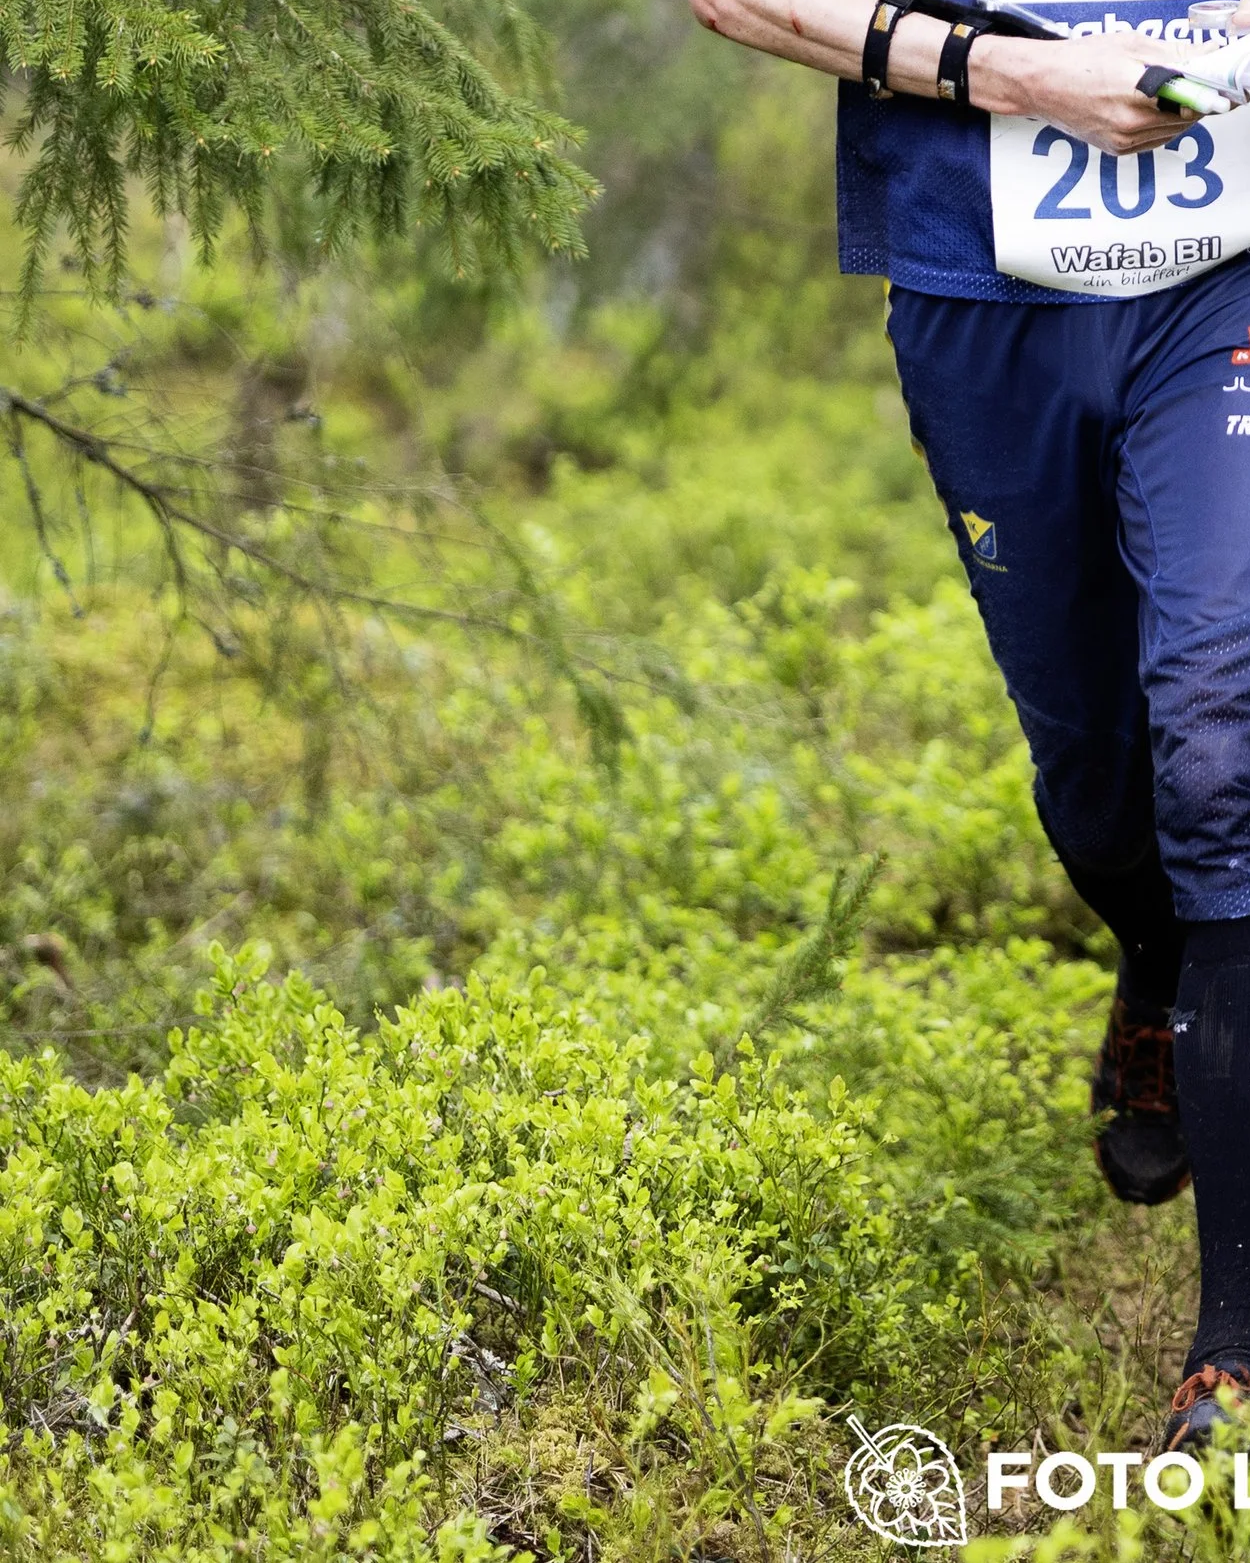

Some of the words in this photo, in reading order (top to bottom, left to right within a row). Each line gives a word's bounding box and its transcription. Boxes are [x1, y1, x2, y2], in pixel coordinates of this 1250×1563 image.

[1032, 121, 1224, 220] 203
[1050, 242, 1167, 274] Wafab
[1174, 235, 1222, 266] Bil
[1083, 275, 1112, 287] din
